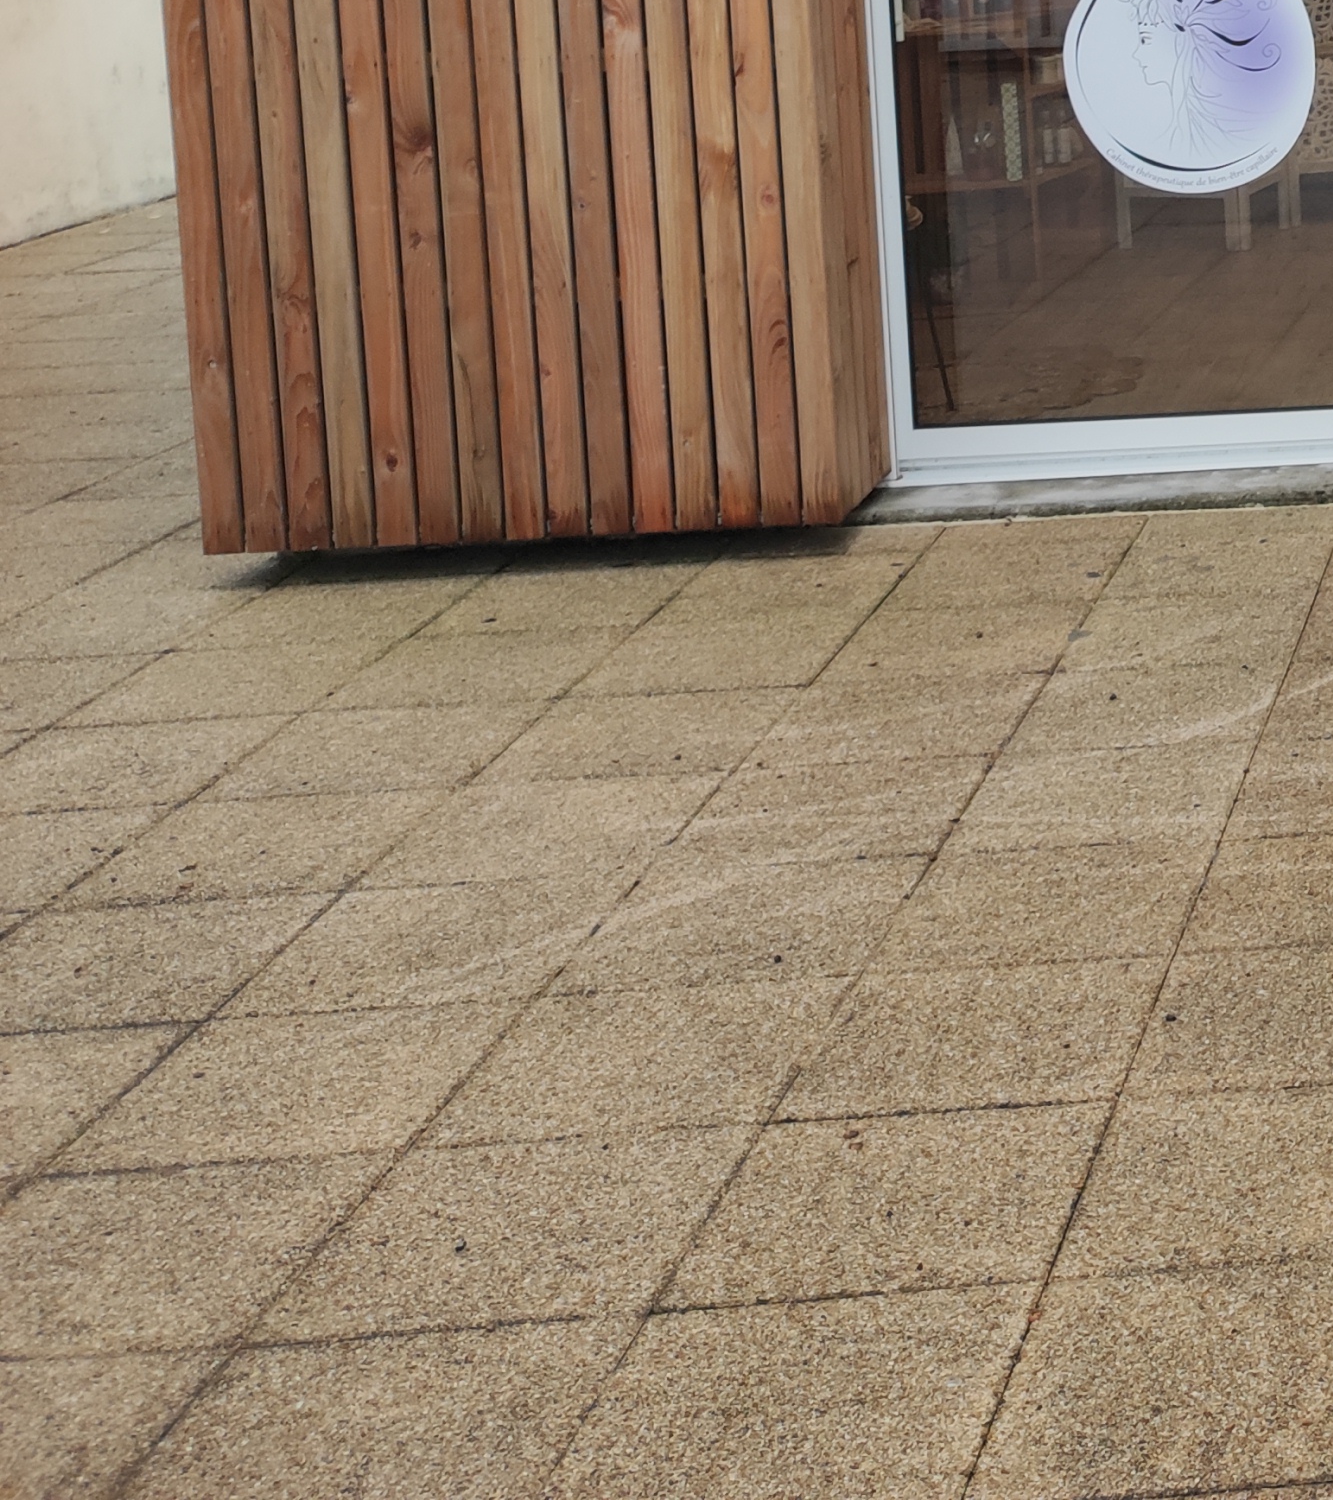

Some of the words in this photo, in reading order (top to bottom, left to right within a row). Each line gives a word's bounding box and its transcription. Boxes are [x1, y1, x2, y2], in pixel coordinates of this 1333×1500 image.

[1106, 148, 1135, 172] Cabinet
[1136, 167, 1194, 189] thérapeutique
[1196, 177, 1207, 186] de
[1208, 169, 1245, 186] bien-être
[1245, 146, 1278, 174] capillaire
